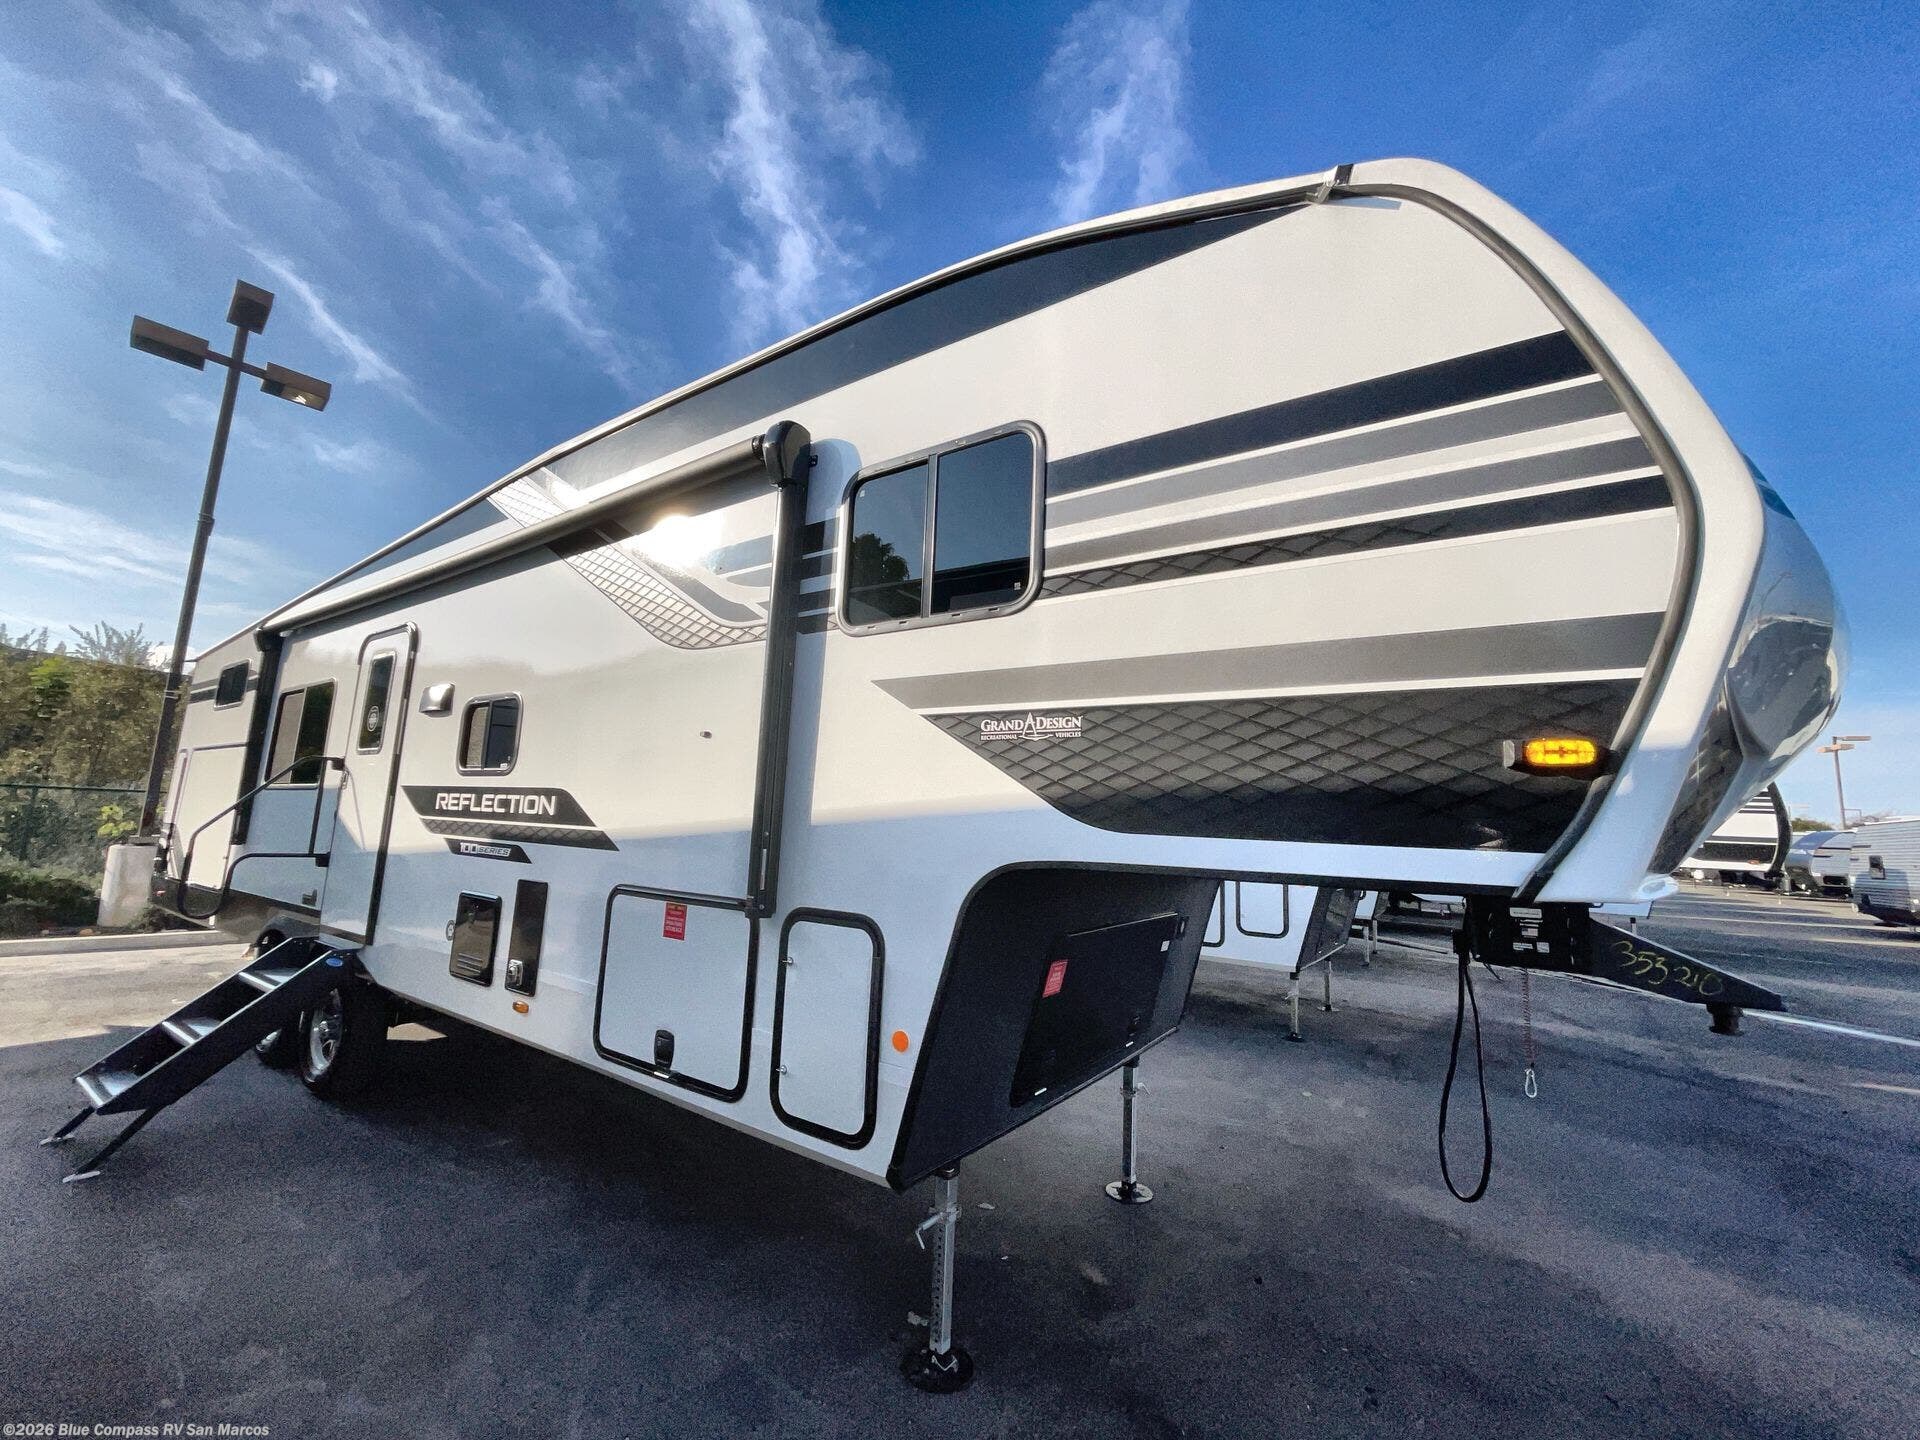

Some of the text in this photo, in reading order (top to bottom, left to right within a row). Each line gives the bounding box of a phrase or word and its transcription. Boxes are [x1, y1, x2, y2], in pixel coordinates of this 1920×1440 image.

[980, 716, 1082, 732] GRAND DESIGN
[435, 792, 556, 816] REFLECTION
[478, 845, 511, 857] SERIES
